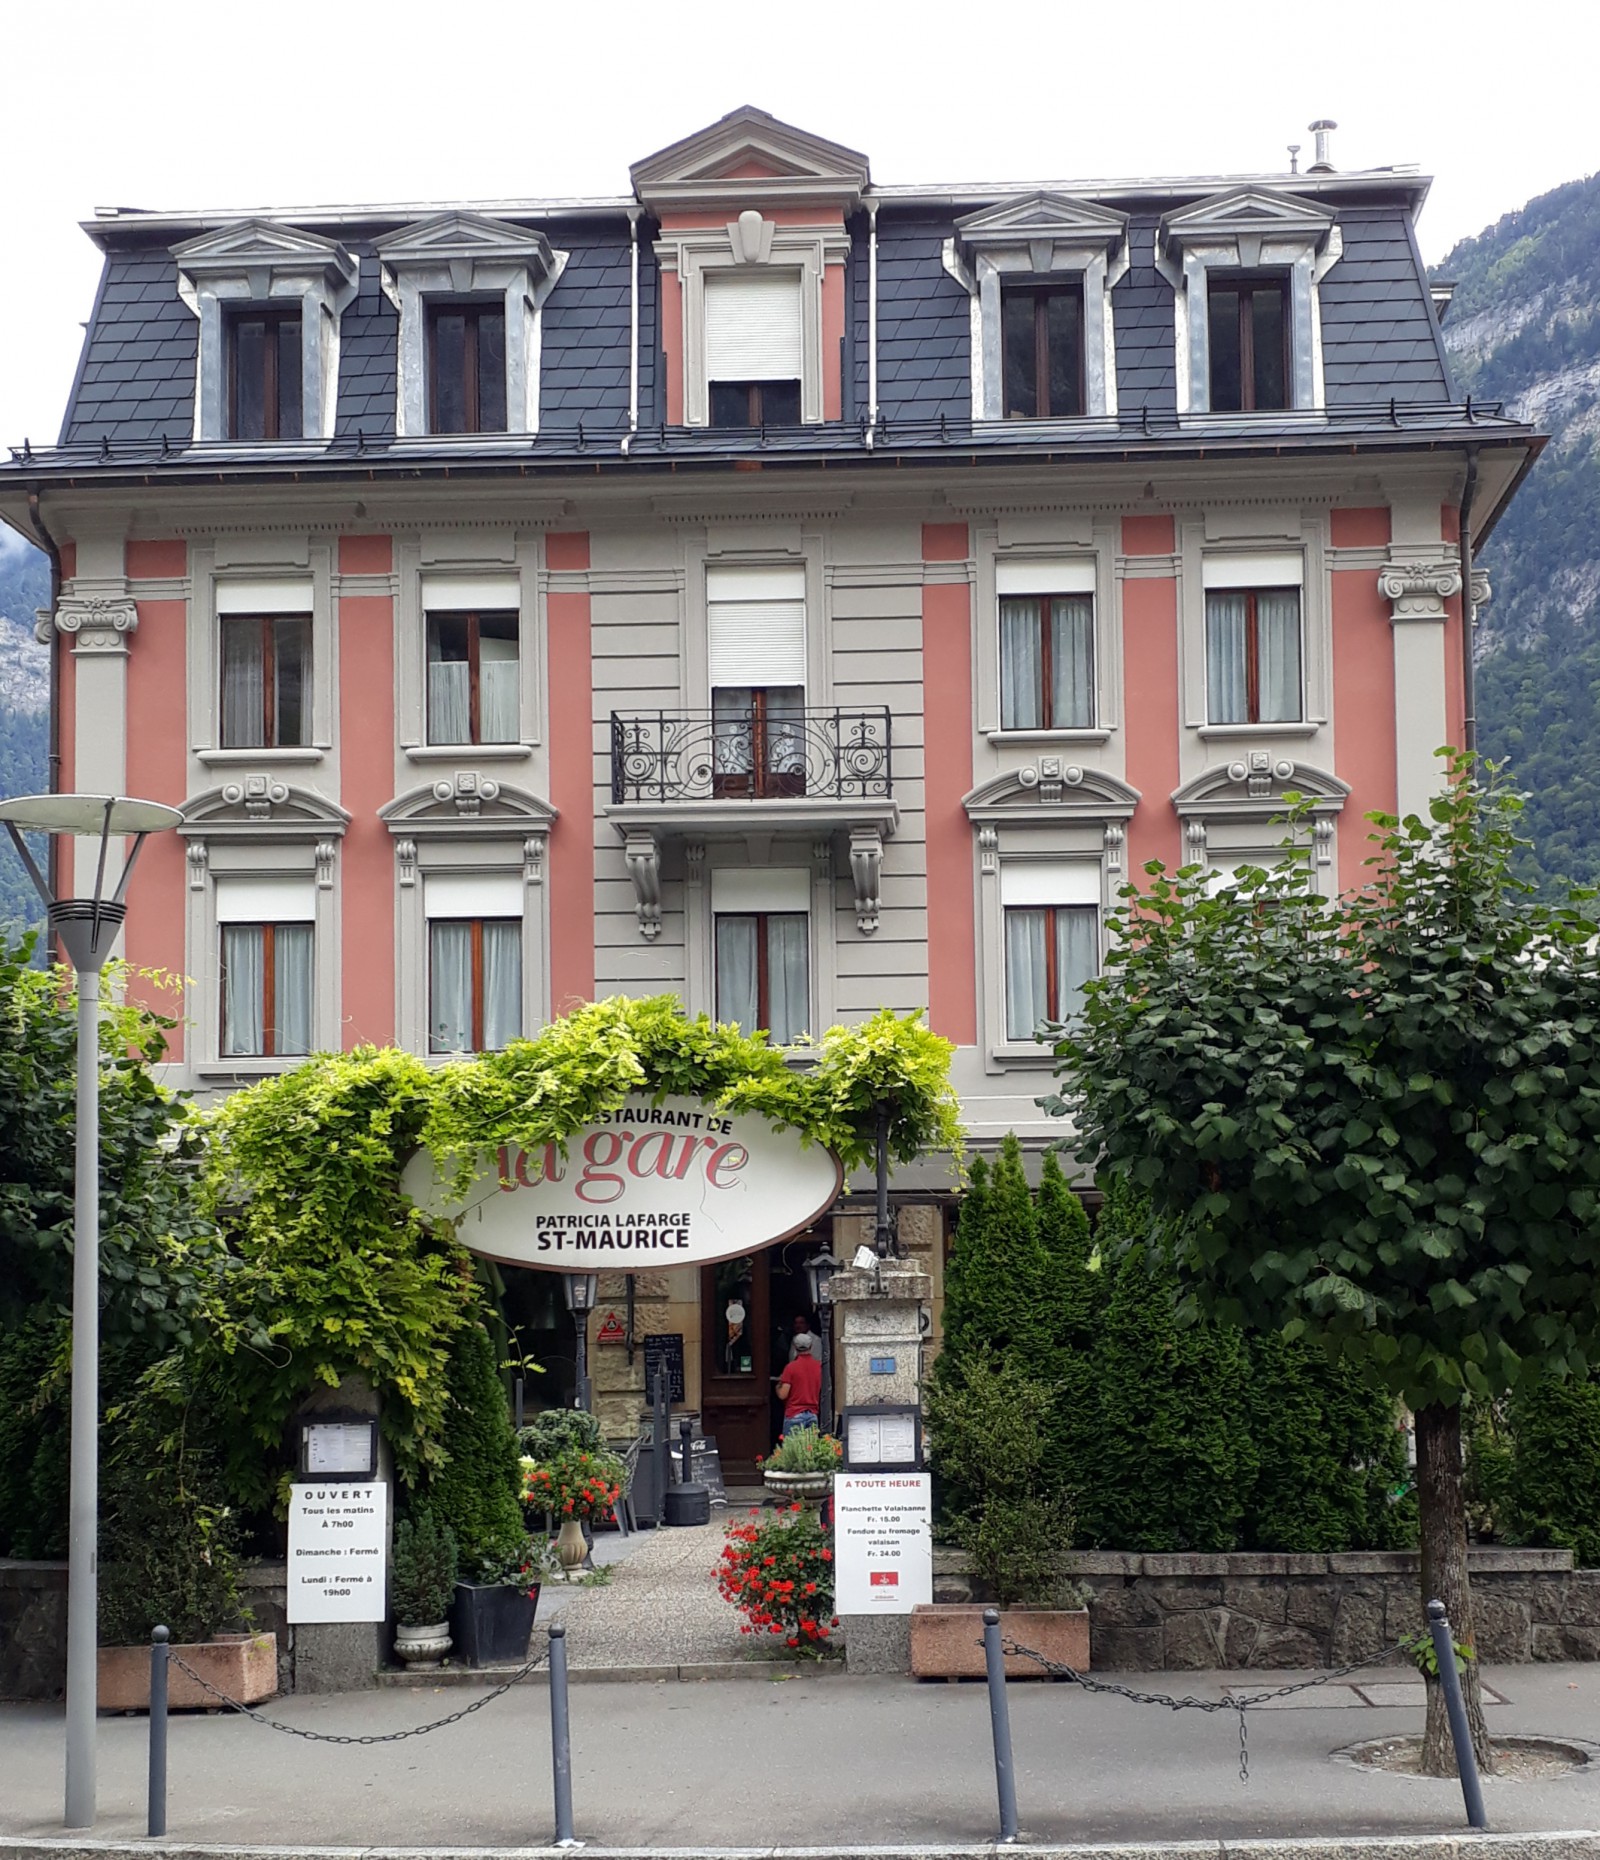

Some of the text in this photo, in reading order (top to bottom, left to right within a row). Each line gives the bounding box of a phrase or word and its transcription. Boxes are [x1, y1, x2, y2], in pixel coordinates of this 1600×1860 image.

[584, 1108, 733, 1135] STAURANT DE
[574, 1130, 749, 1204] gare
[536, 1213, 691, 1229] PATRICIA LAFARGE
[537, 1228, 690, 1251] ST-MAURICE
[845, 1480, 852, 1488] A
[855, 1480, 886, 1488] TOUTE
[304, 1490, 373, 1500] OUVERT
[331, 1520, 354, 1528] 7h00
[296, 1548, 342, 1556] Dimanche
[349, 1547, 379, 1555] Fermé
[301, 1576, 327, 1584] Lundi
[335, 1575, 364, 1583] Fermé
[323, 1588, 351, 1596] 19h00
